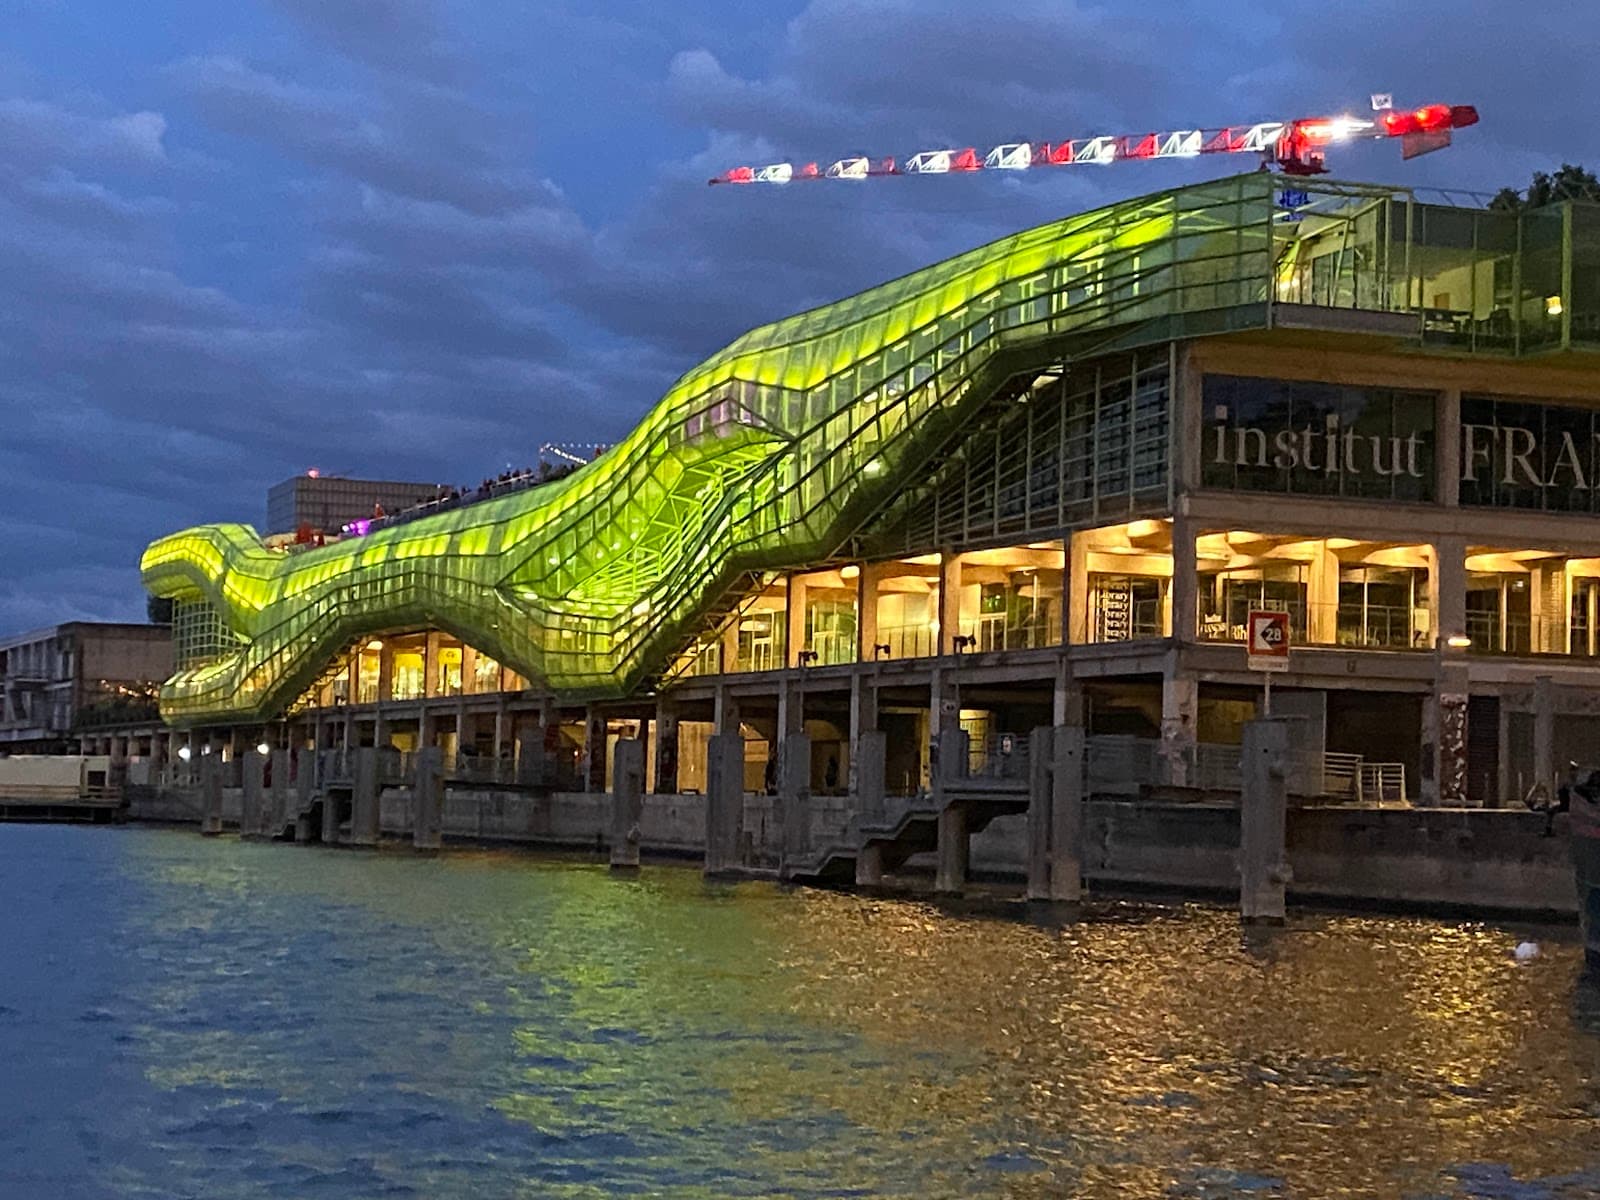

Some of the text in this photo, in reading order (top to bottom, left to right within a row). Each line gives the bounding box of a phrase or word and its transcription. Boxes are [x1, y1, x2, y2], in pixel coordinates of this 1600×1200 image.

[1213, 404, 1600, 490] institut FRA
[1265, 628, 1282, 642] 28
